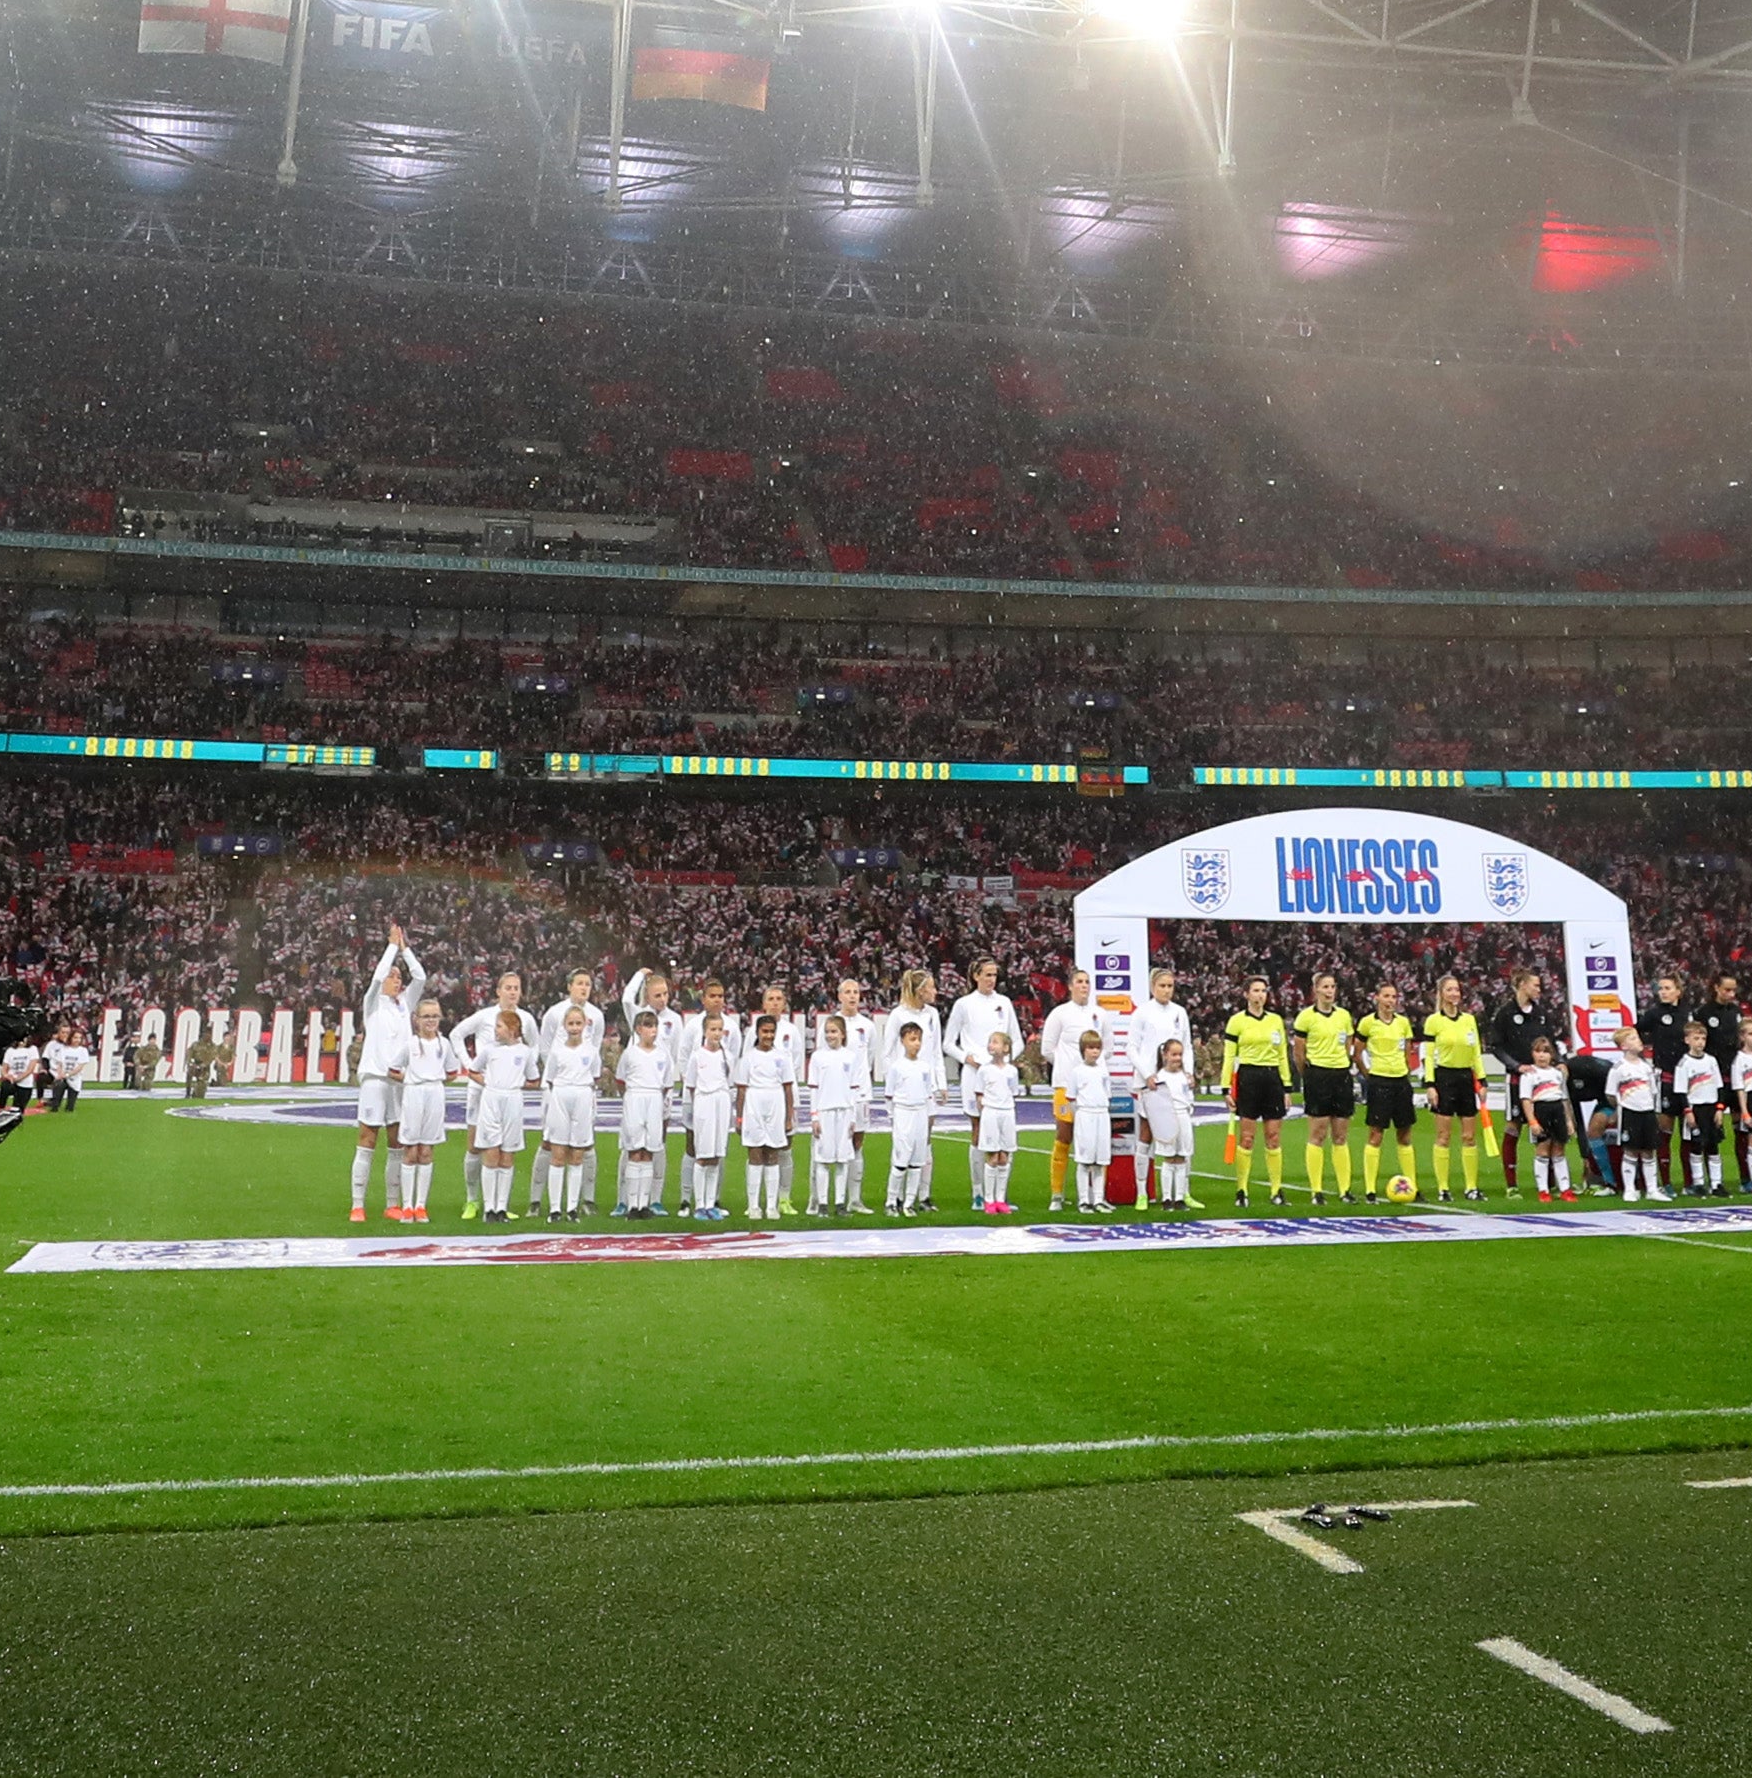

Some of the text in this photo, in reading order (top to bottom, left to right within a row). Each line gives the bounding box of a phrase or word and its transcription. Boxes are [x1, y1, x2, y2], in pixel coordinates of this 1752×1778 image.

[332, 13, 435, 56] FIFA
[498, 35, 587, 66] UEFA
[1275, 837, 1441, 915] LIONESSES
